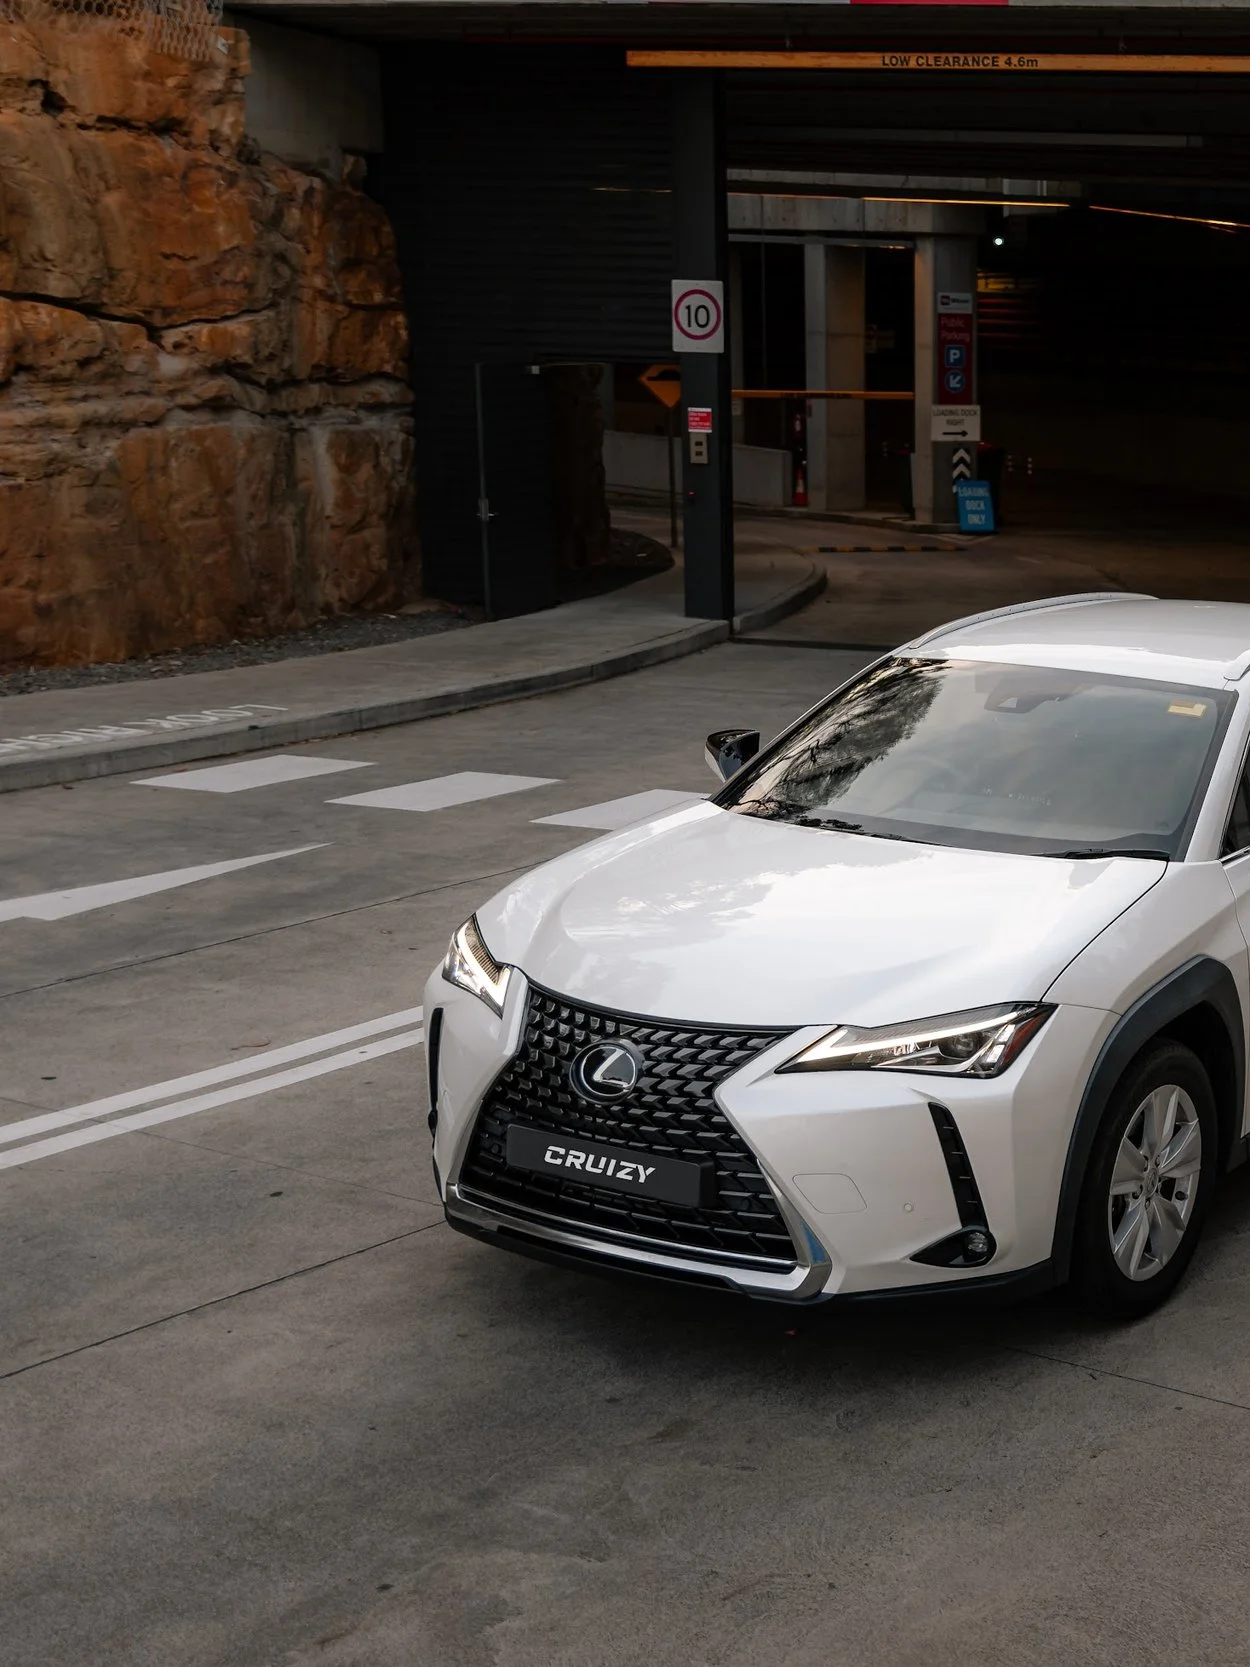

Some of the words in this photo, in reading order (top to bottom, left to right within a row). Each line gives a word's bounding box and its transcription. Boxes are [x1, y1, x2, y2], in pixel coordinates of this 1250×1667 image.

[882, 55, 911, 67] LOW
[915, 55, 1000, 68] CLEARANCE
[1005, 56, 1039, 68] 4.6m
[684, 304, 710, 329] 10
[950, 350, 961, 363] P
[123, 703, 289, 729] LOOK
[0, 725, 147, 752] RIGH
[544, 1145, 656, 1184] CRUIZY
